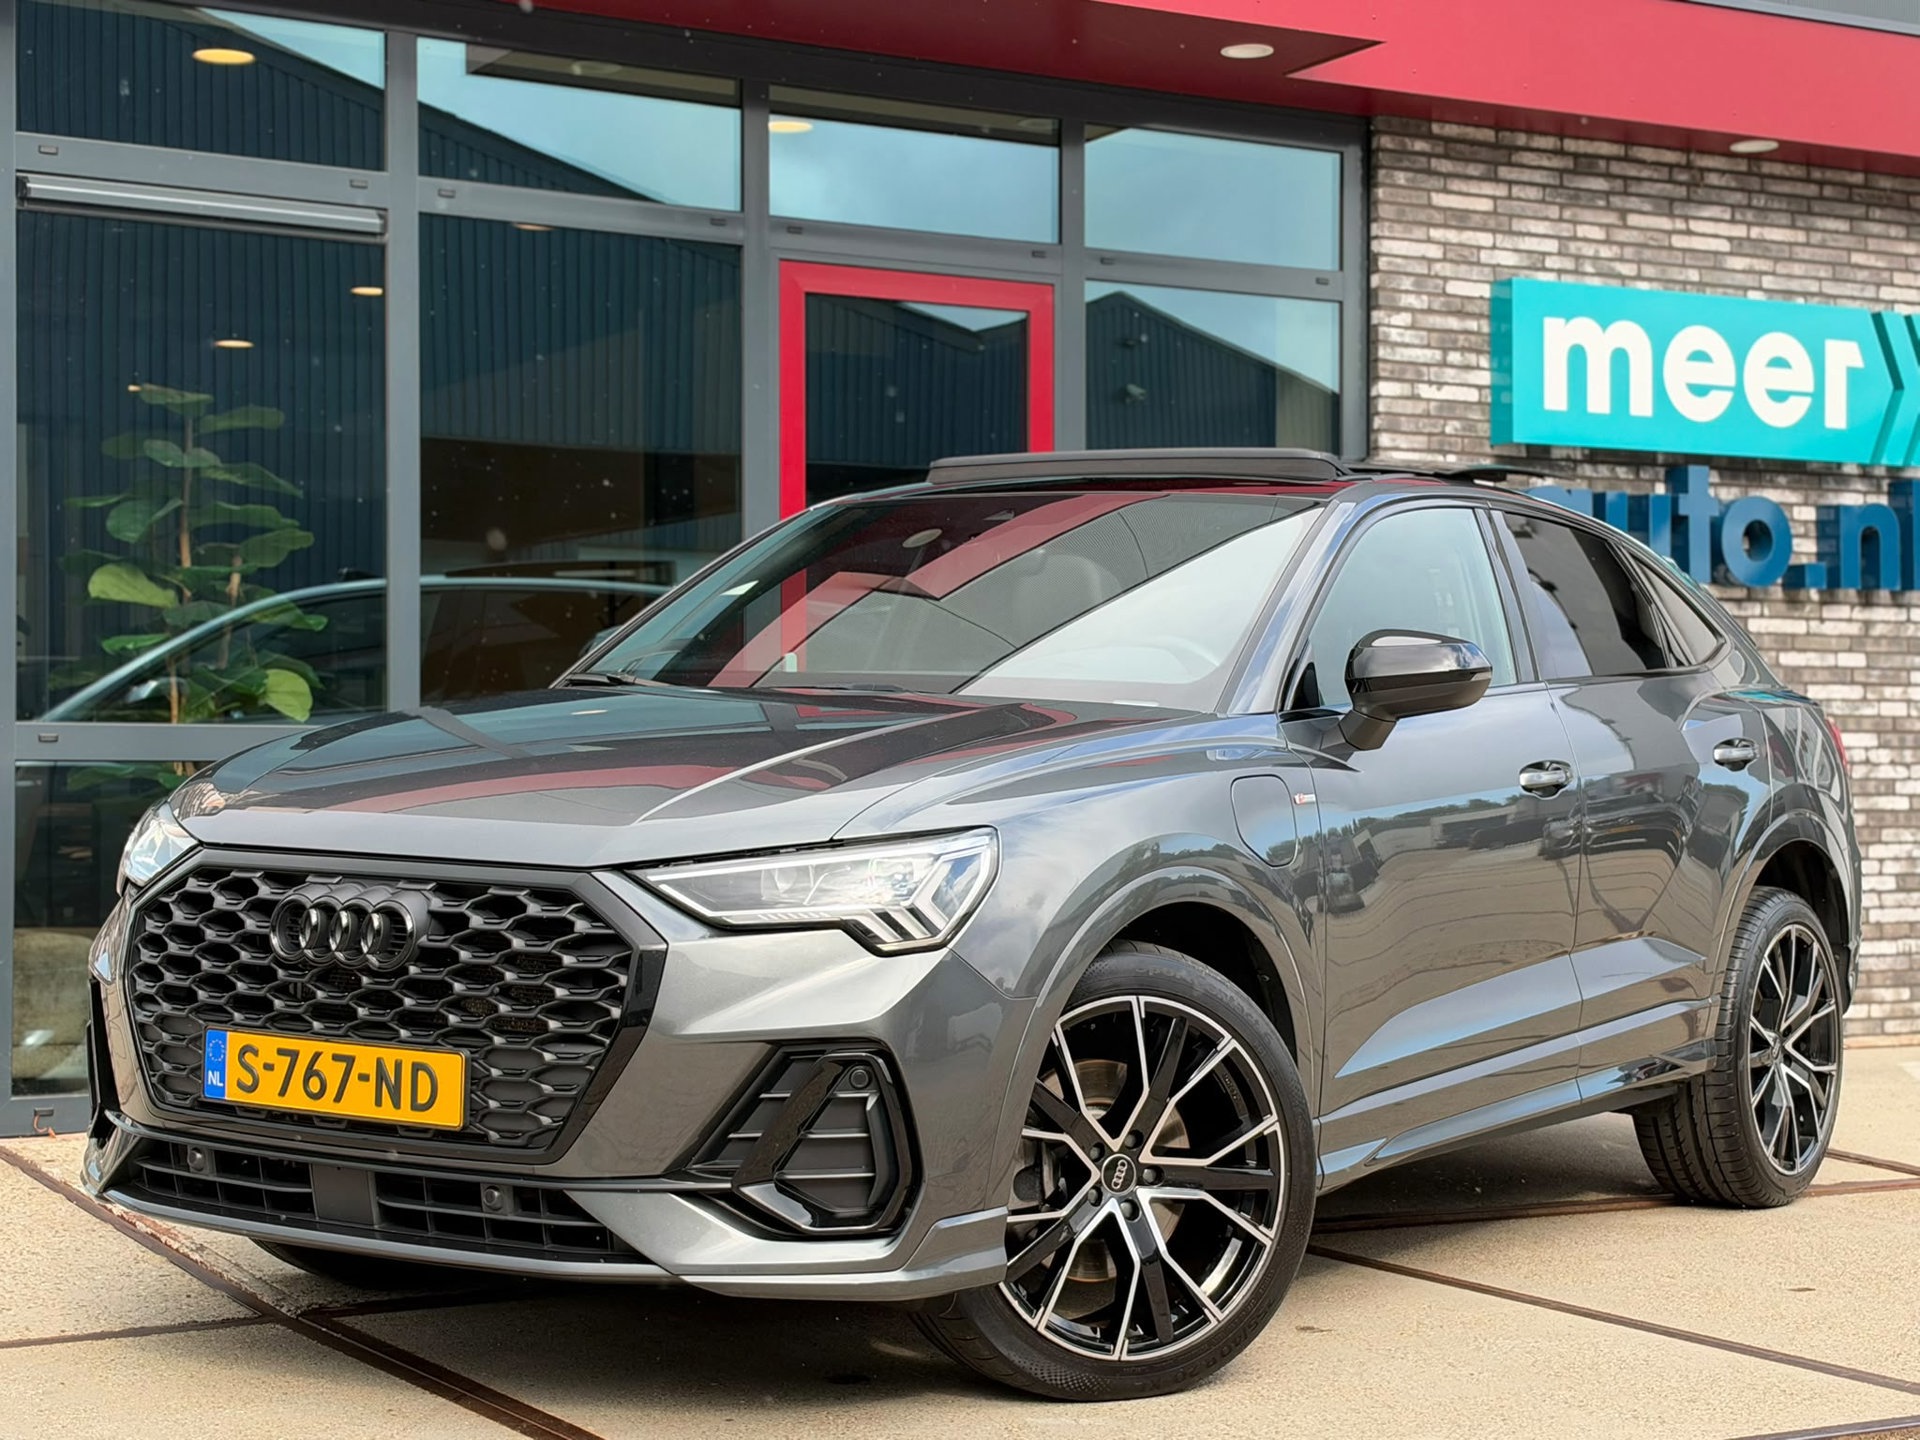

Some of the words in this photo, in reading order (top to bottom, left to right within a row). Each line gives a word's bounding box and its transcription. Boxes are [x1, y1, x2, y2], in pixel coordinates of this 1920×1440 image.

[1543, 316, 1865, 430] meer
[207, 1071, 224, 1087] NL
[236, 1043, 438, 1112] S-767-ND
